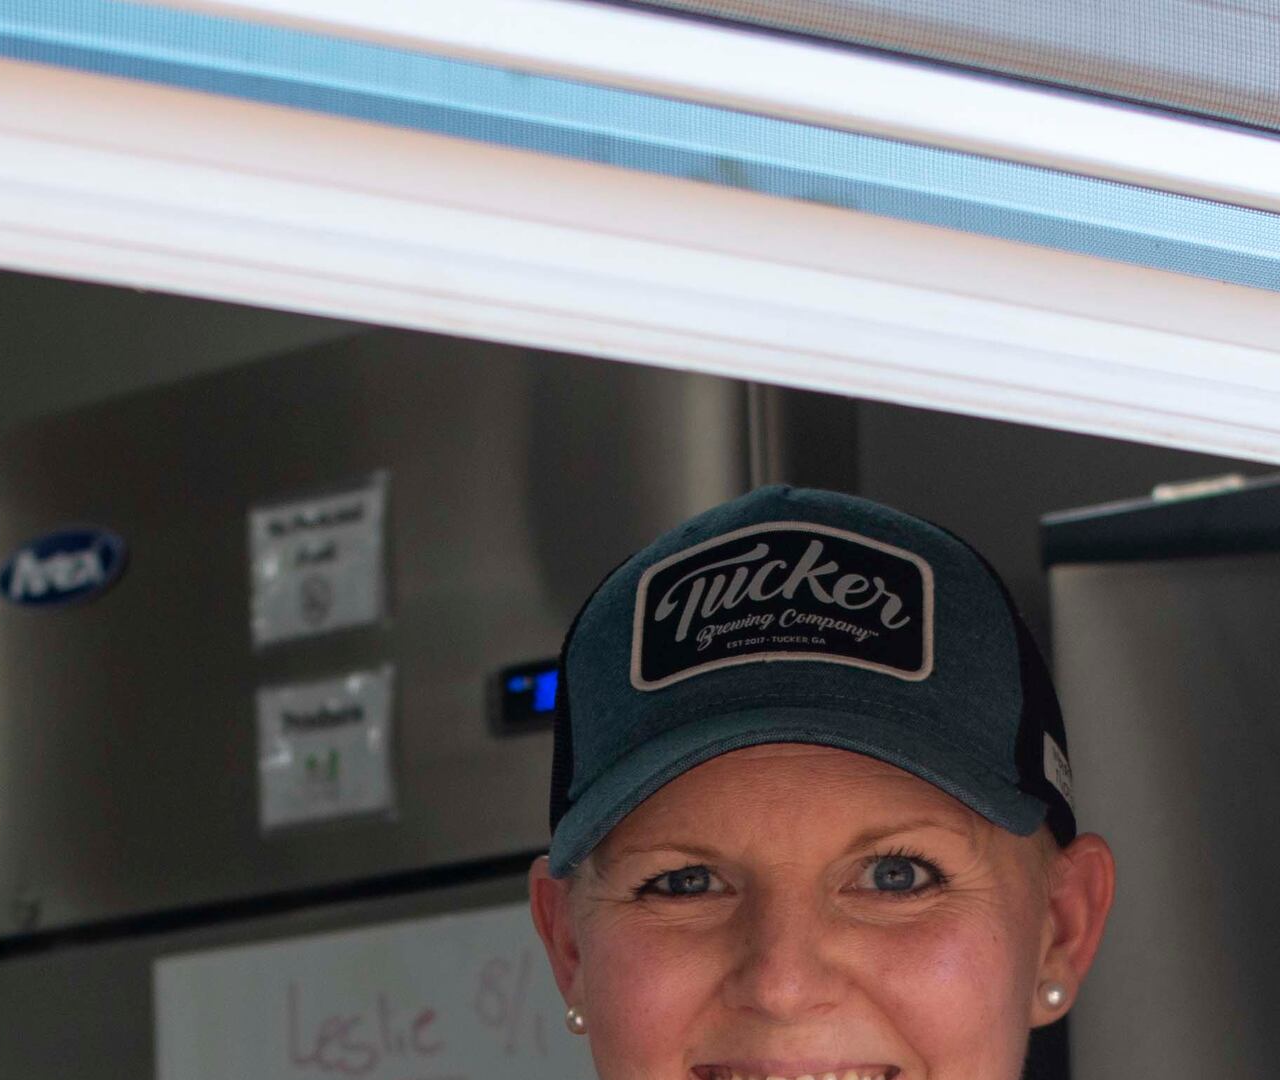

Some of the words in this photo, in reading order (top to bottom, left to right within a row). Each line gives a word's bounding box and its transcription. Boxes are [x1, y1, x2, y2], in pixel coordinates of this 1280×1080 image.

[654, 539, 910, 643] Tucker
[696, 612, 775, 651] Brewing
[743, 636, 766, 647] 2017
[811, 636, 827, 645] GA
[286, 979, 448, 1076] Leslie
